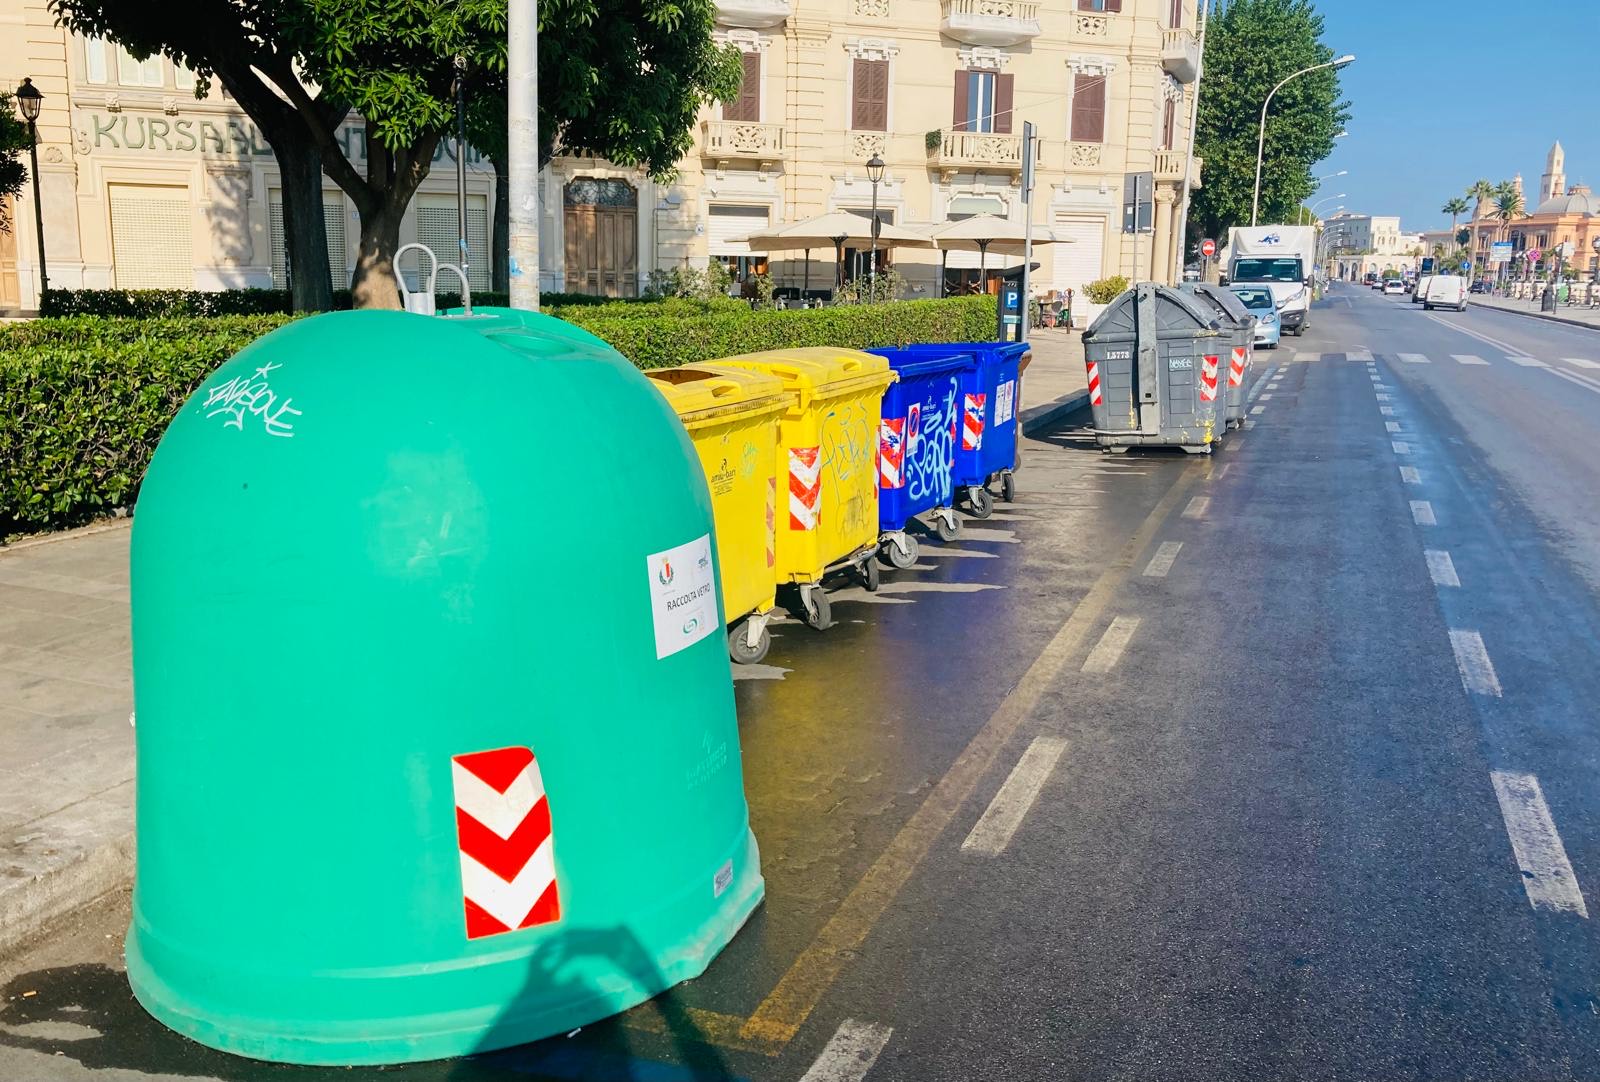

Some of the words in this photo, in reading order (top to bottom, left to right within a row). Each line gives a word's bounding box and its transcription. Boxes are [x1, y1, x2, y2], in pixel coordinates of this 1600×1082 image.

[92, 114, 274, 156] KURSAAL
[1007, 292, 1018, 305] P
[666, 591, 698, 611] RACCOLTA
[696, 583, 711, 598] VETRO
